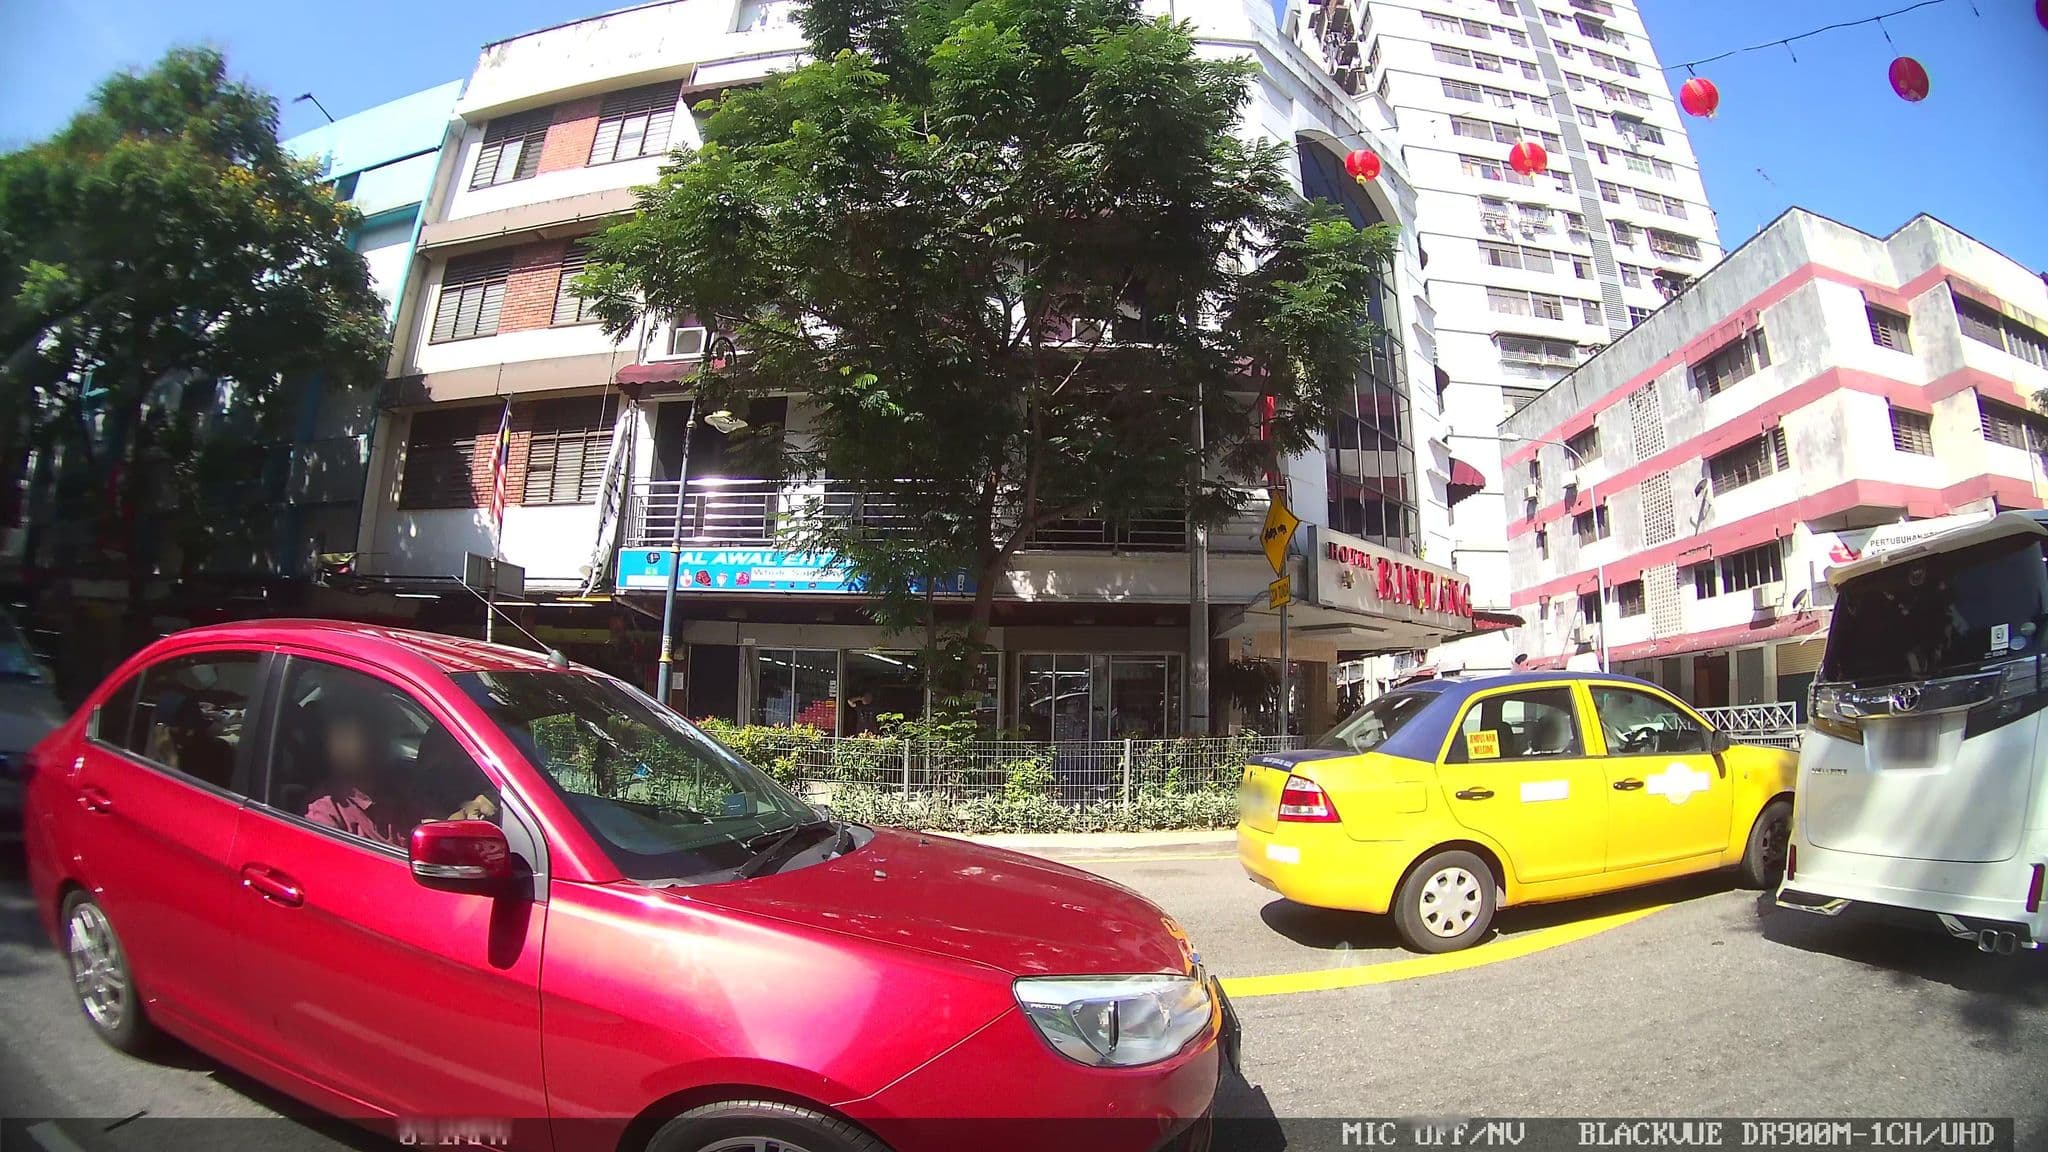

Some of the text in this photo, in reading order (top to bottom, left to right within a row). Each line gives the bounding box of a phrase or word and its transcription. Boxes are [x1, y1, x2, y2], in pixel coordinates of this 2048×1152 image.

[679, 552, 709, 566] AL
[710, 552, 778, 567] AWAL
[1326, 541, 1375, 571] HOTEL
[1376, 557, 1473, 618] BINTANG
